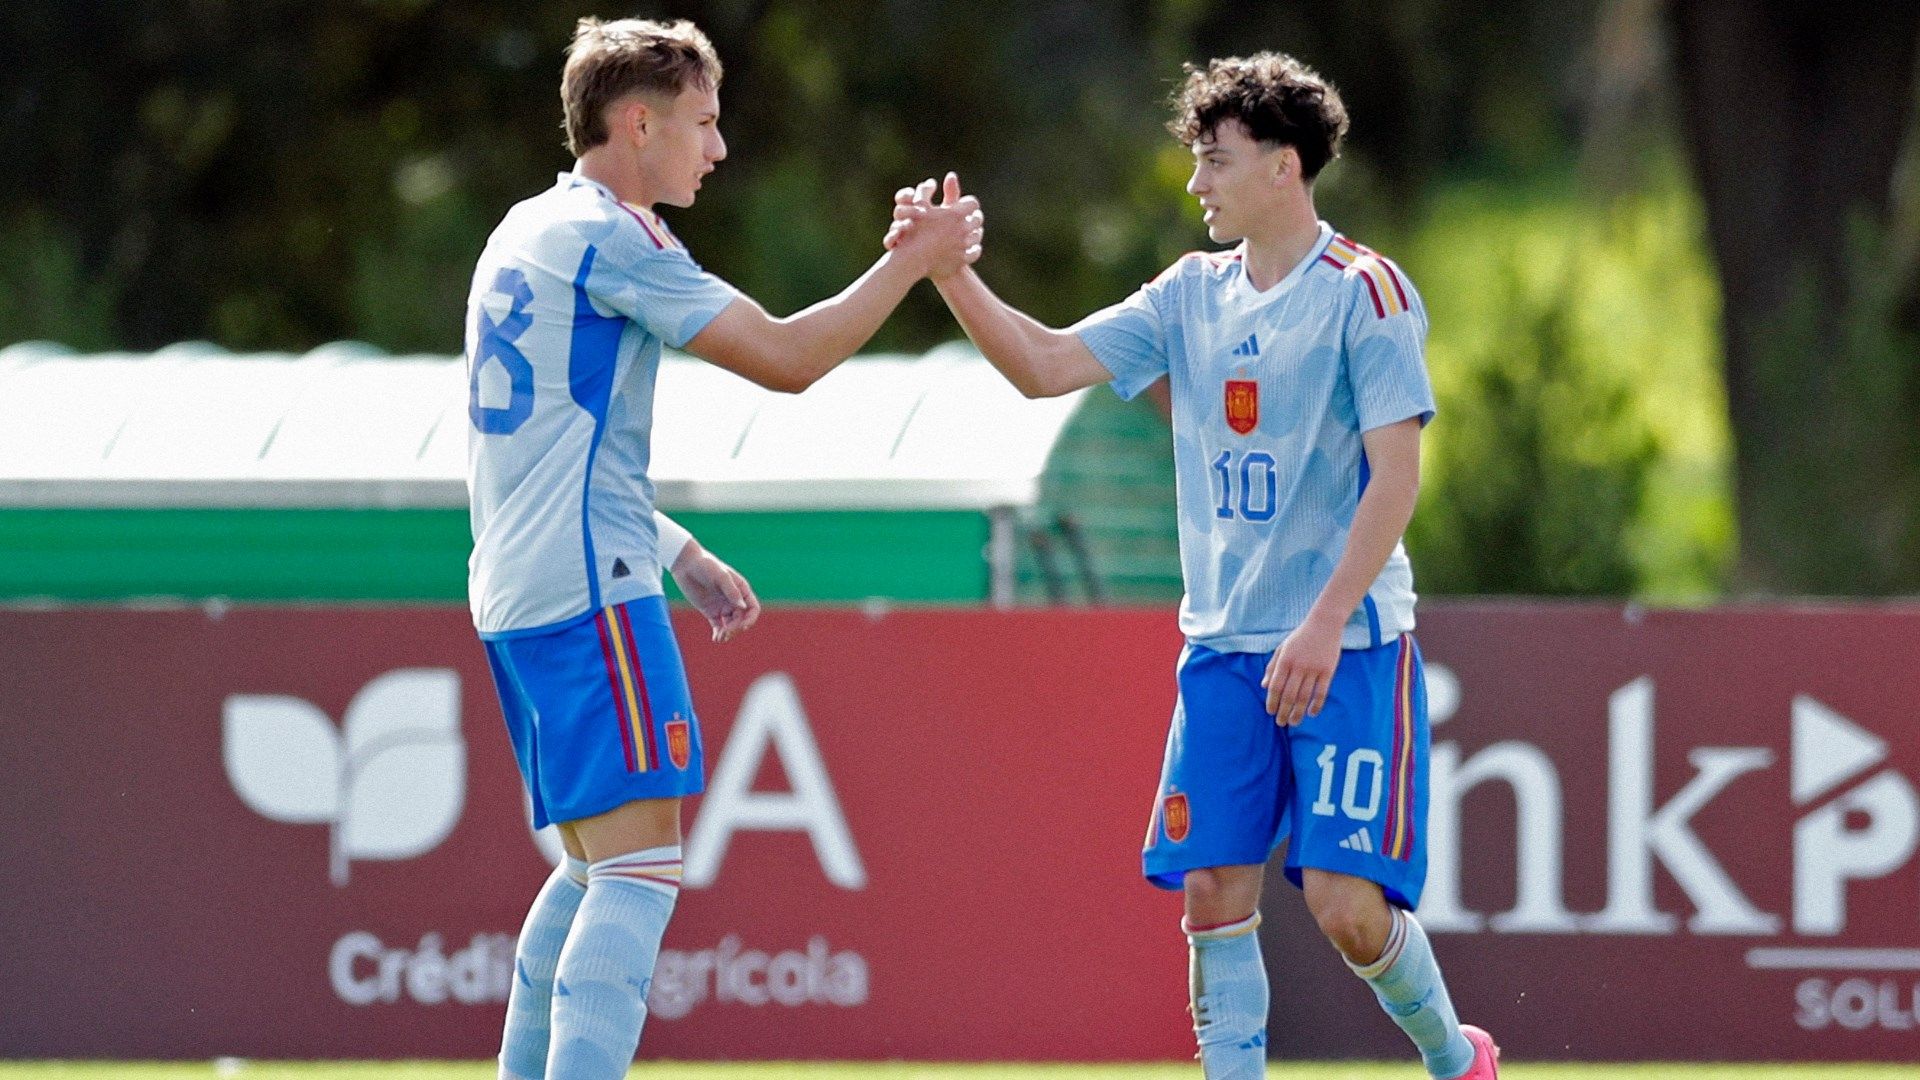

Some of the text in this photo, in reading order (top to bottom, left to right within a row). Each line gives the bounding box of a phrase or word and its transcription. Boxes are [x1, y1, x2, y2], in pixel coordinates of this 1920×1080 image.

[468, 266, 535, 436] 8
[1212, 450, 1277, 523] 10
[1312, 744, 1383, 821] 10
[329, 931, 869, 1021] Crédi grícola
[1793, 978, 1920, 1030] SOL
